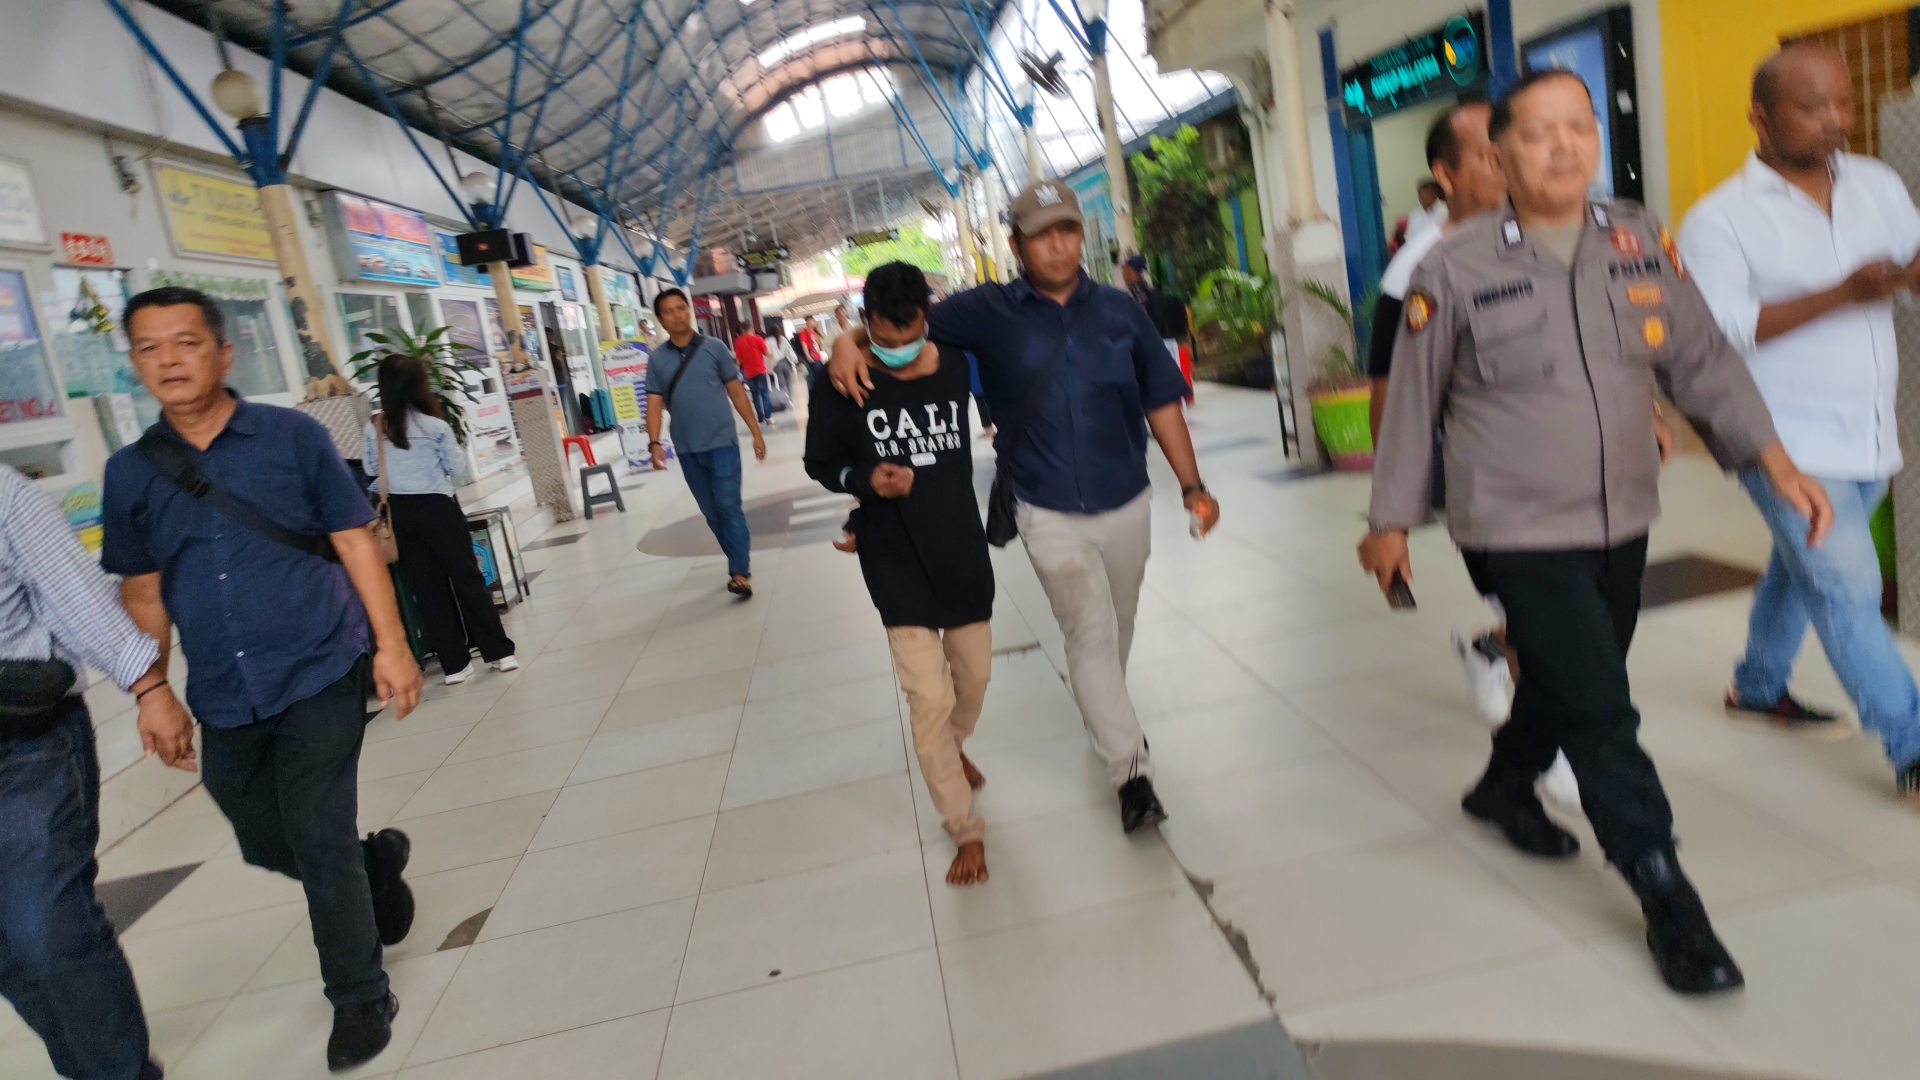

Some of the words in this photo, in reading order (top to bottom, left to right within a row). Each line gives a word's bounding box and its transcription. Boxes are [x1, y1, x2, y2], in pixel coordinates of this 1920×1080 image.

[866, 400, 960, 441] CALI
[874, 440, 905, 458] U.S.
[907, 432, 961, 454] STATES
